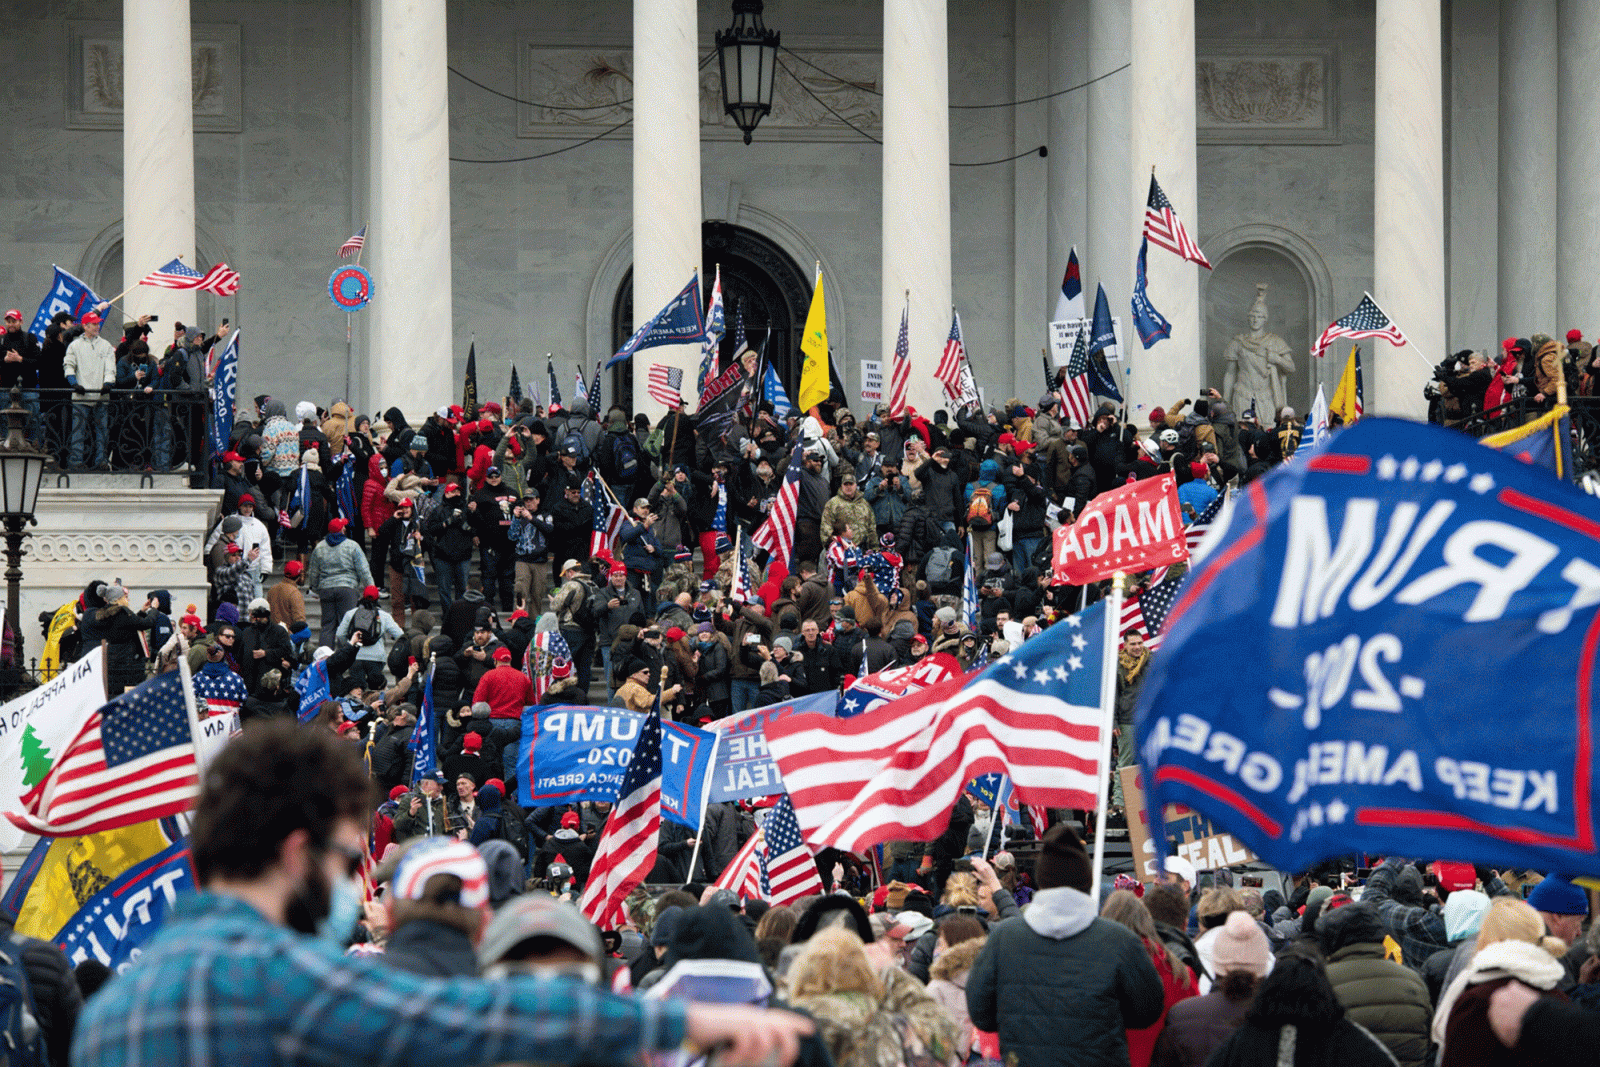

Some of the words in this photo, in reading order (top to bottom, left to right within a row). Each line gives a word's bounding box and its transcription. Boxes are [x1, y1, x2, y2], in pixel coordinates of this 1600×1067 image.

[867, 372, 883, 380] INVIS
[866, 381, 881, 389] ENEM
[861, 390, 881, 400] COMM
